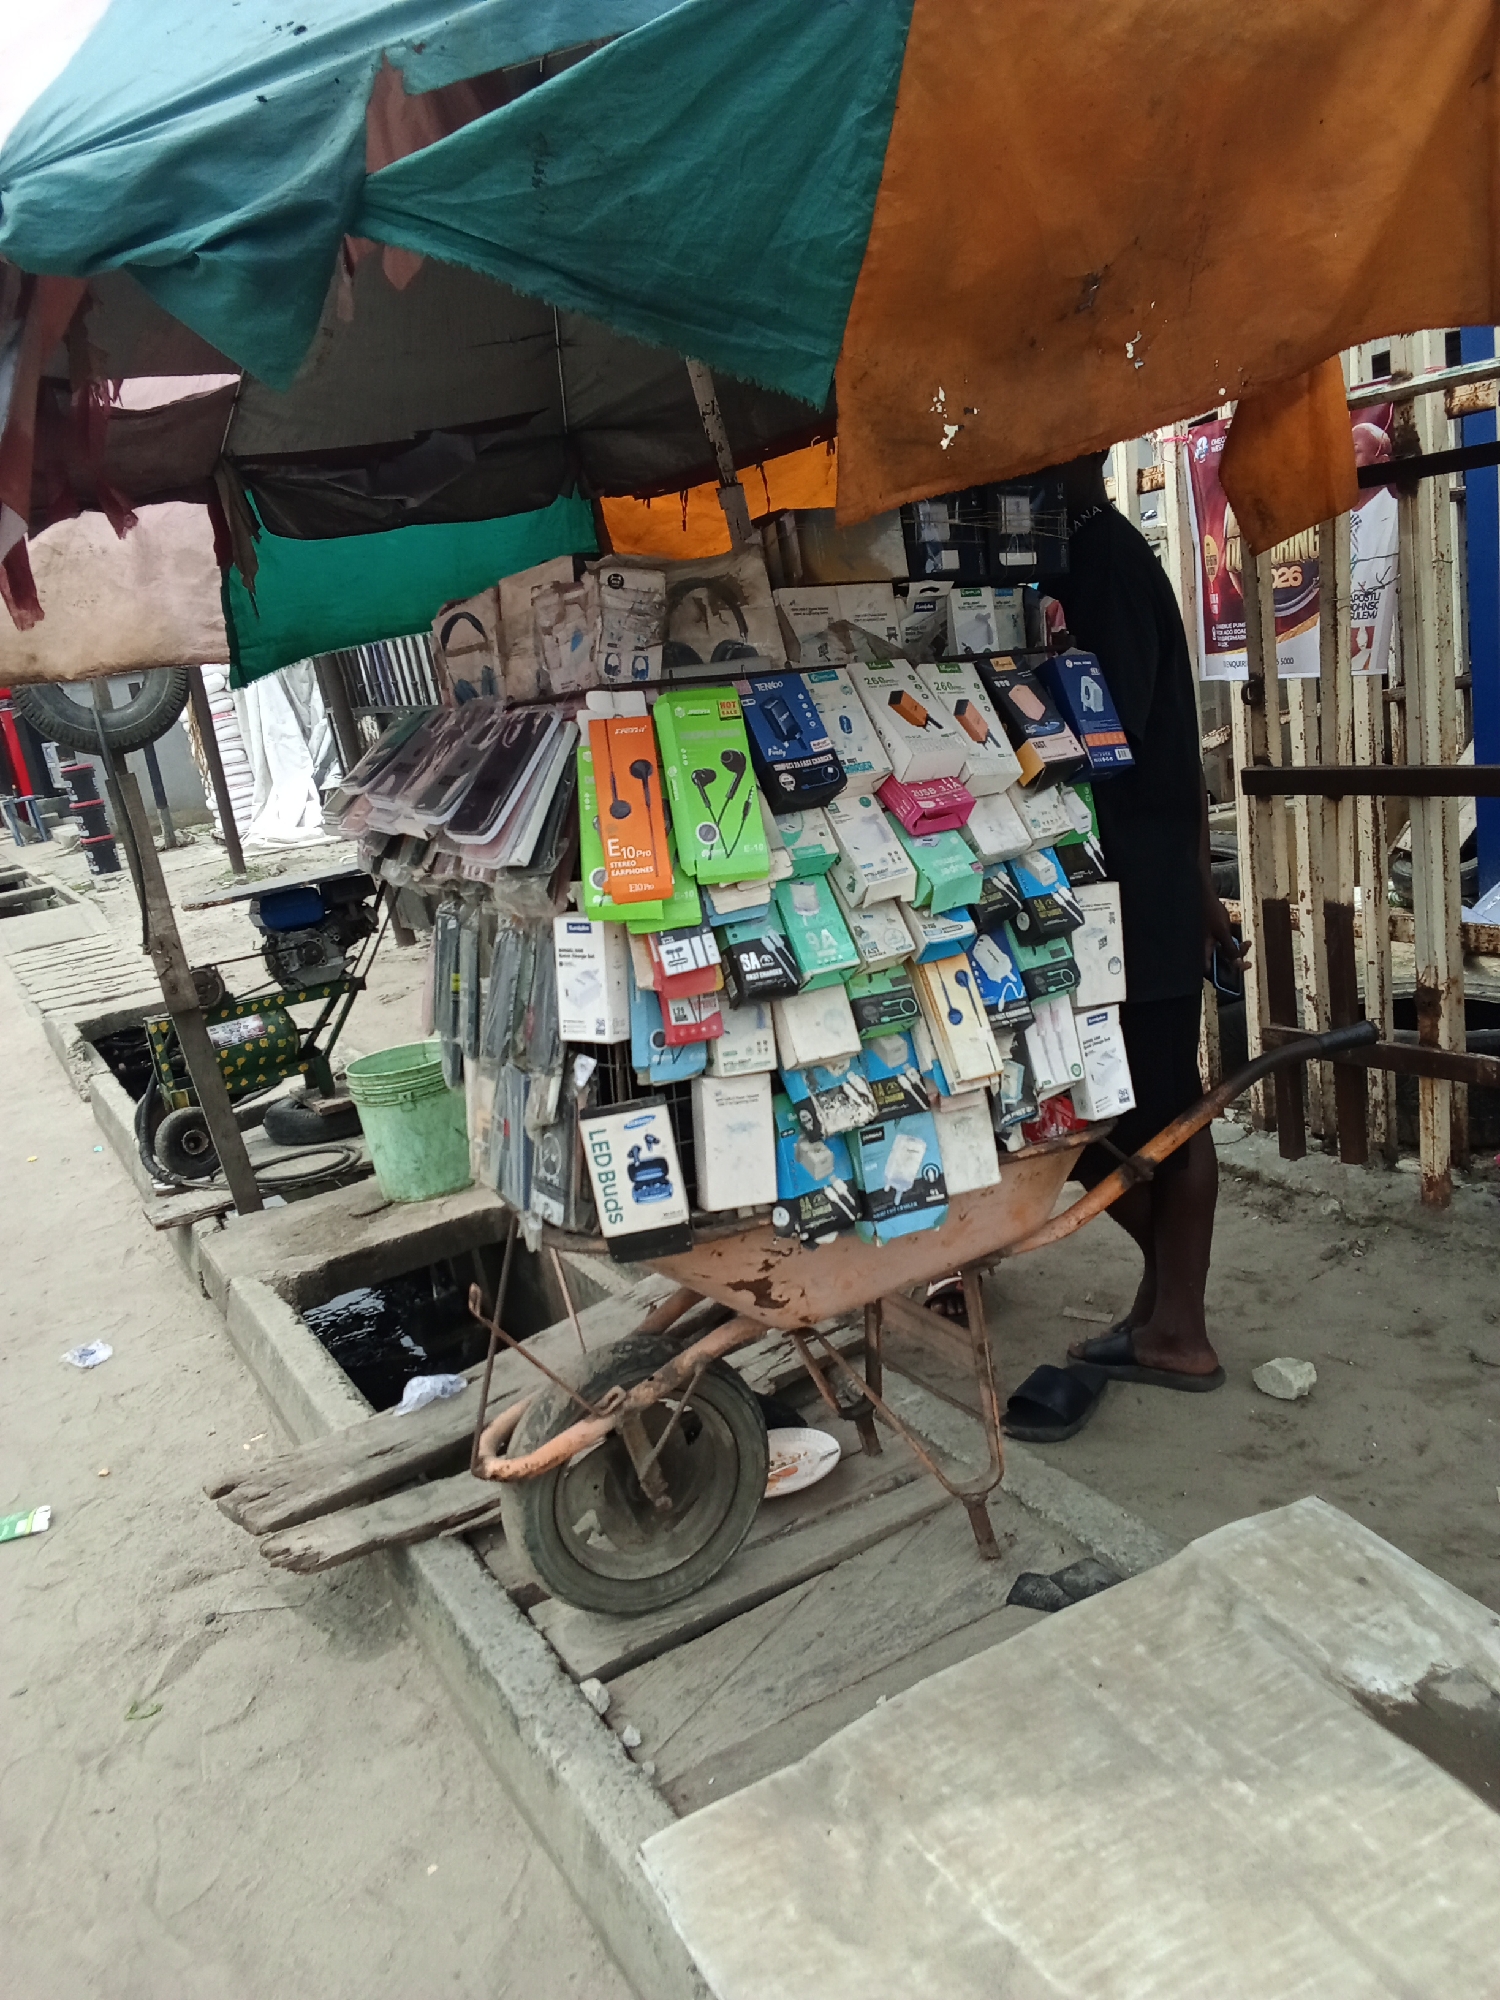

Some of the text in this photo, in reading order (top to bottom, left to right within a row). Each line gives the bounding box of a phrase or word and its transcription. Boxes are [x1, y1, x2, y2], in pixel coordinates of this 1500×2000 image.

[720, 700, 736, 709] HOT
[589, 1128, 624, 1225] LED Buds
